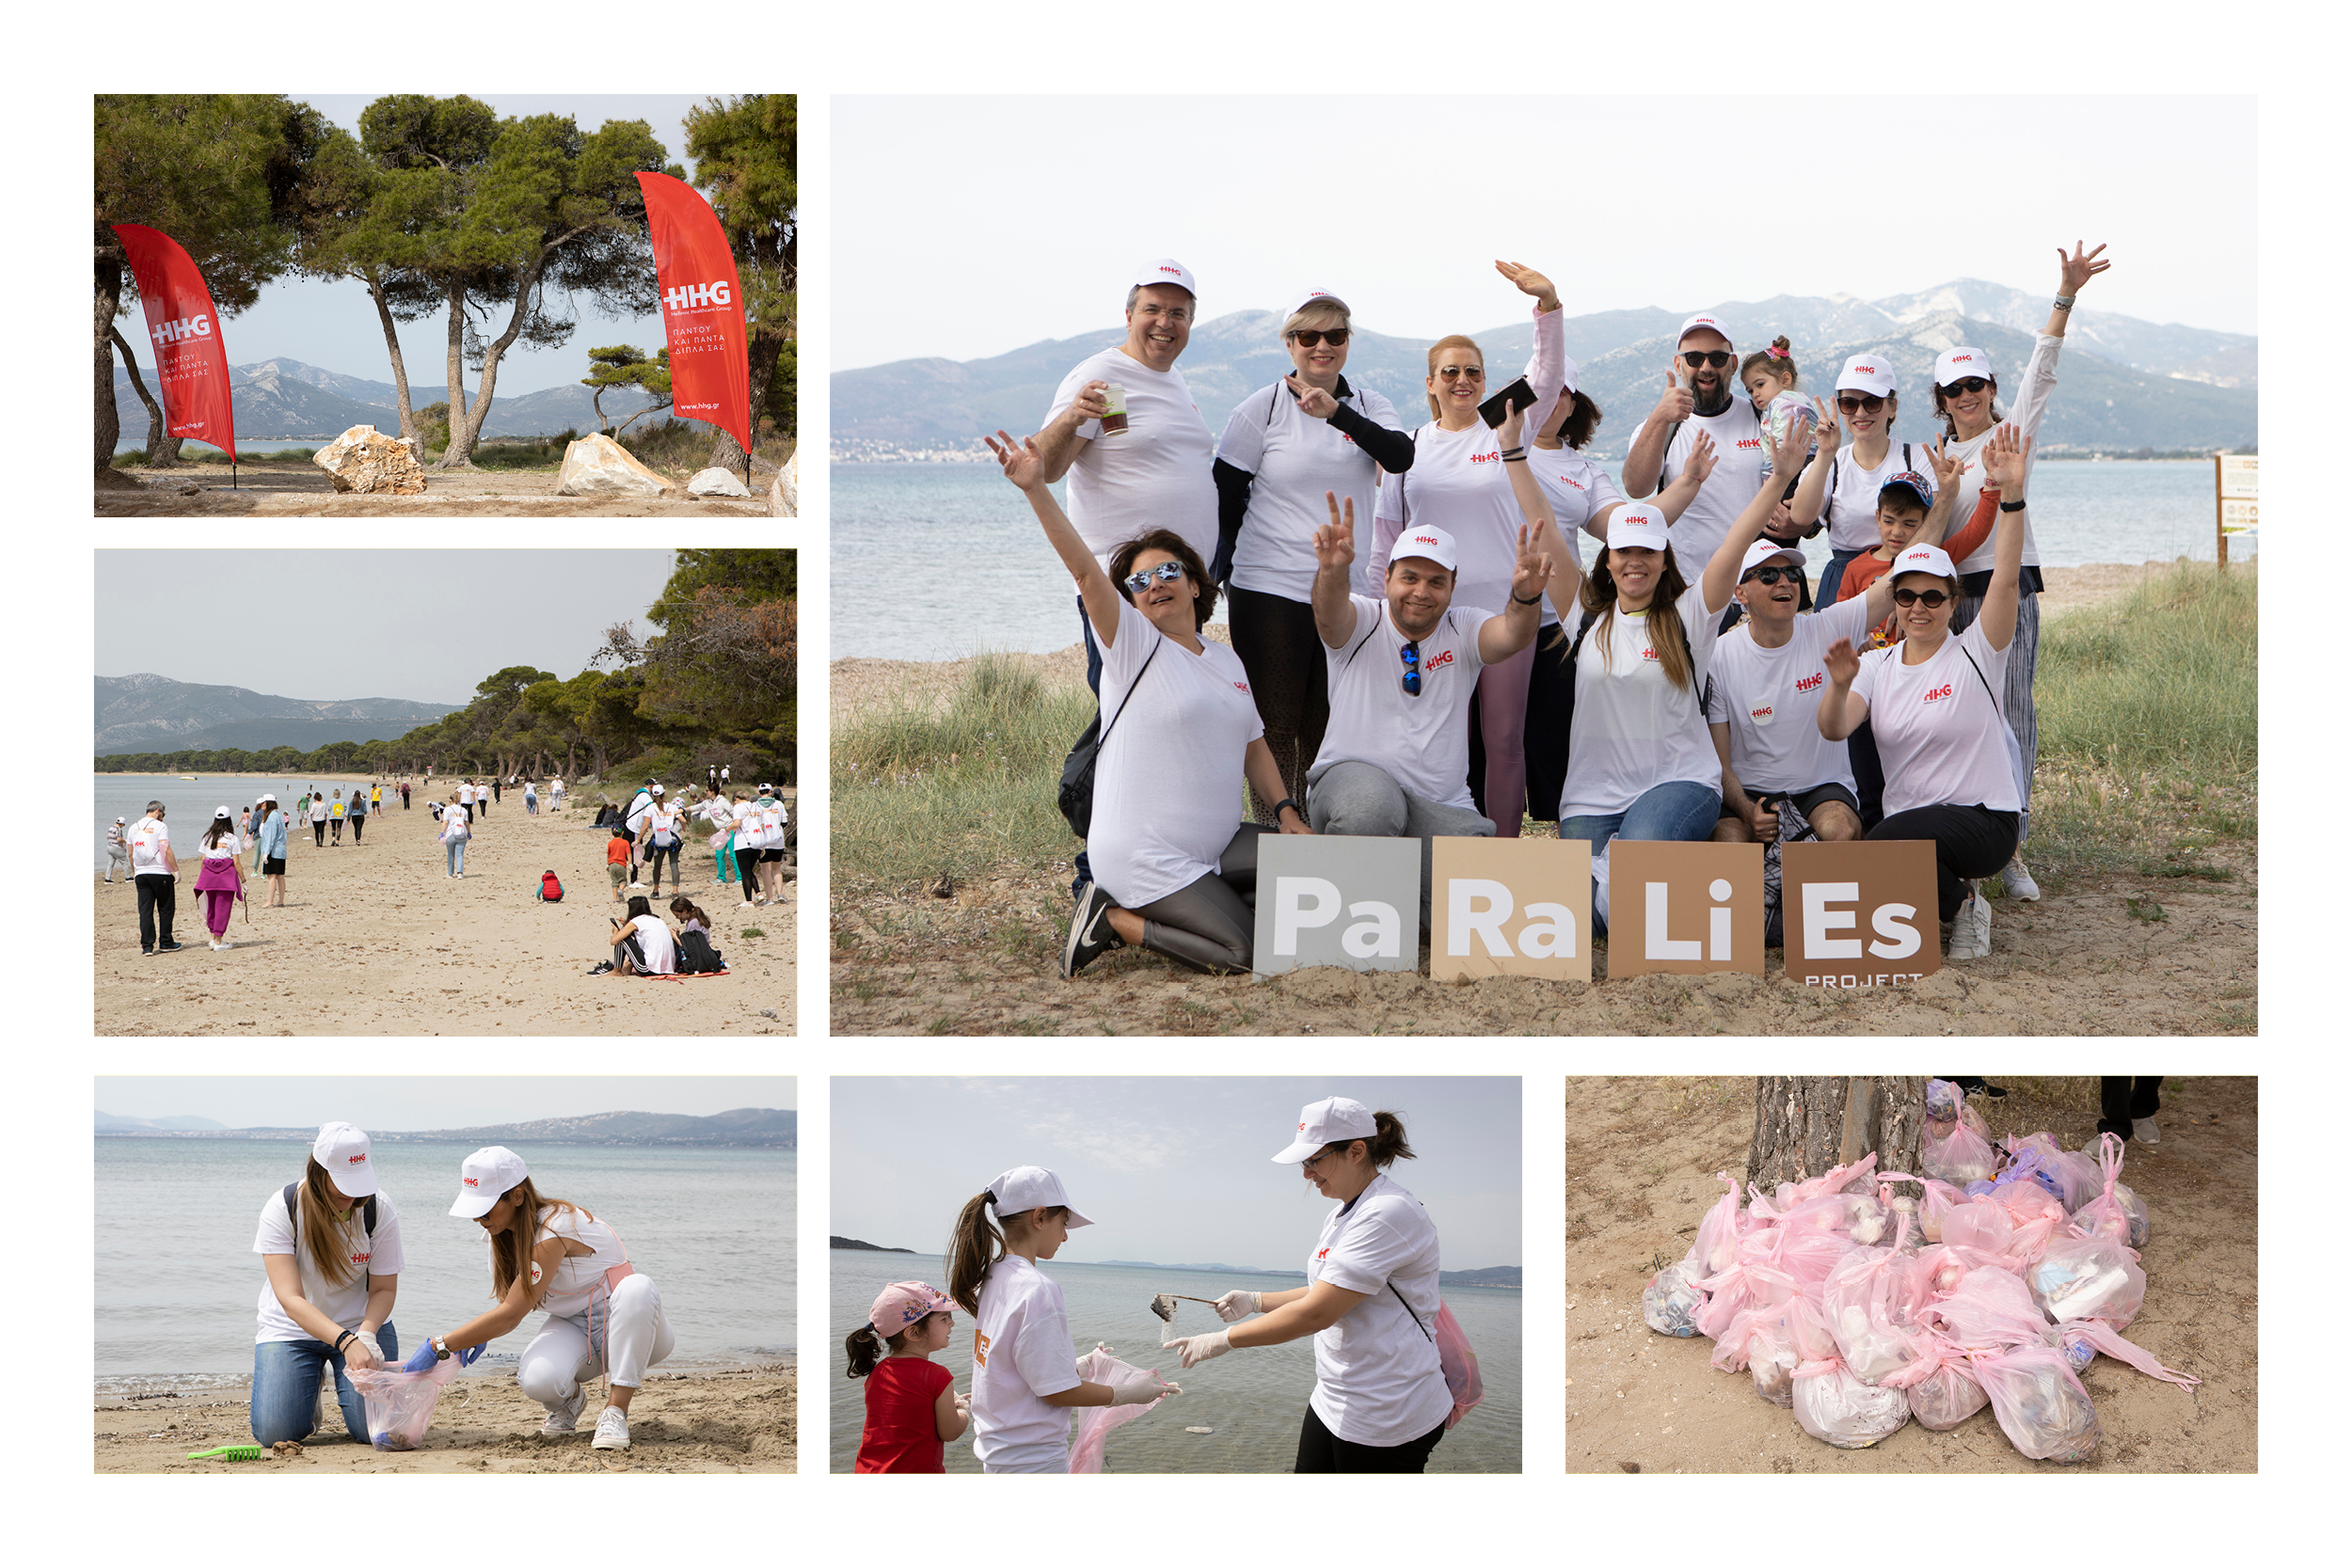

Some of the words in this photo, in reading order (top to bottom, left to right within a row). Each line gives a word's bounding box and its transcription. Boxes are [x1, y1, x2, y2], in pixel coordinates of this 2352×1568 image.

[1158, 265, 1181, 276] HHG
[663, 280, 731, 310] HHG
[151, 314, 211, 344] HHG
[673, 325, 711, 336] ΠΑΝΤΟΥ
[674, 338, 691, 346] ΚΑΙ
[693, 334, 724, 343] ΠΑΝΤΑ
[675, 345, 705, 355] ΔΙΠΛΑ
[163, 354, 195, 366] ΠΑΝΤΟΥ
[1951, 355, 1973, 363] HHG
[180, 360, 208, 371] ΠΑΝΤΑ
[1854, 366, 1875, 374] HHG
[192, 369, 208, 377] ΣΑΣ
[172, 421, 205, 432] www.hhg.gr
[1470, 451, 1500, 463] HHG
[1625, 516, 1648, 525] HHG
[1414, 535, 1438, 546] HHG
[1425, 650, 1454, 672] HHG
[1796, 672, 1822, 691] HHG
[1751, 706, 1773, 718] HHG
[1273, 877, 1401, 958] Pa
[1447, 879, 1576, 958] Ra
[1645, 879, 1732, 961] Li
[1802, 882, 1922, 959] Es
[348, 1152, 366, 1164] HHG
